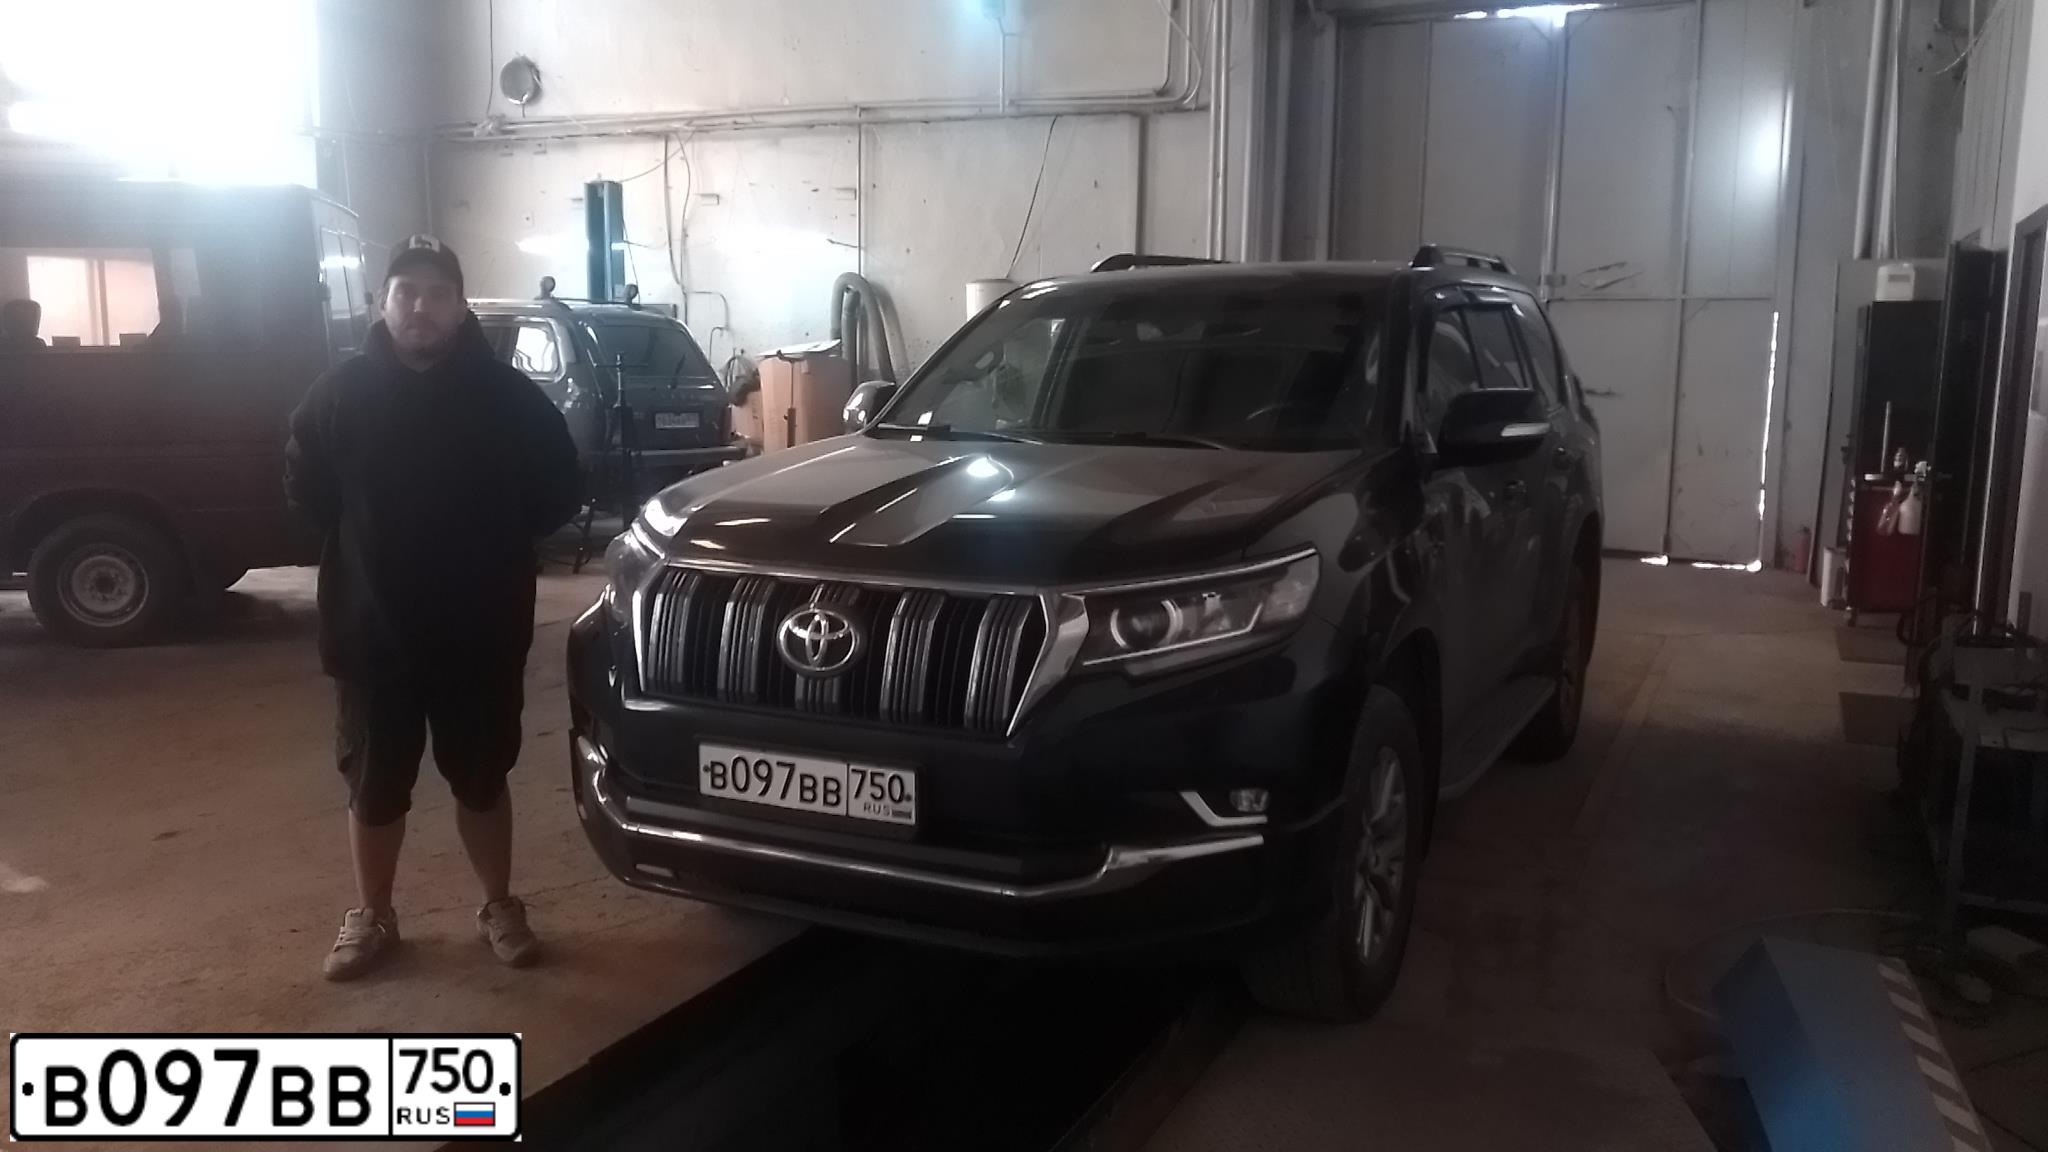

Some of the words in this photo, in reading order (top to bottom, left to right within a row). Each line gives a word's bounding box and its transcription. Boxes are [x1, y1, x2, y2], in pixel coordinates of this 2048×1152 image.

[710, 755, 842, 807] B097BB
[851, 768, 904, 803] 750
[863, 801, 890, 816] RUS
